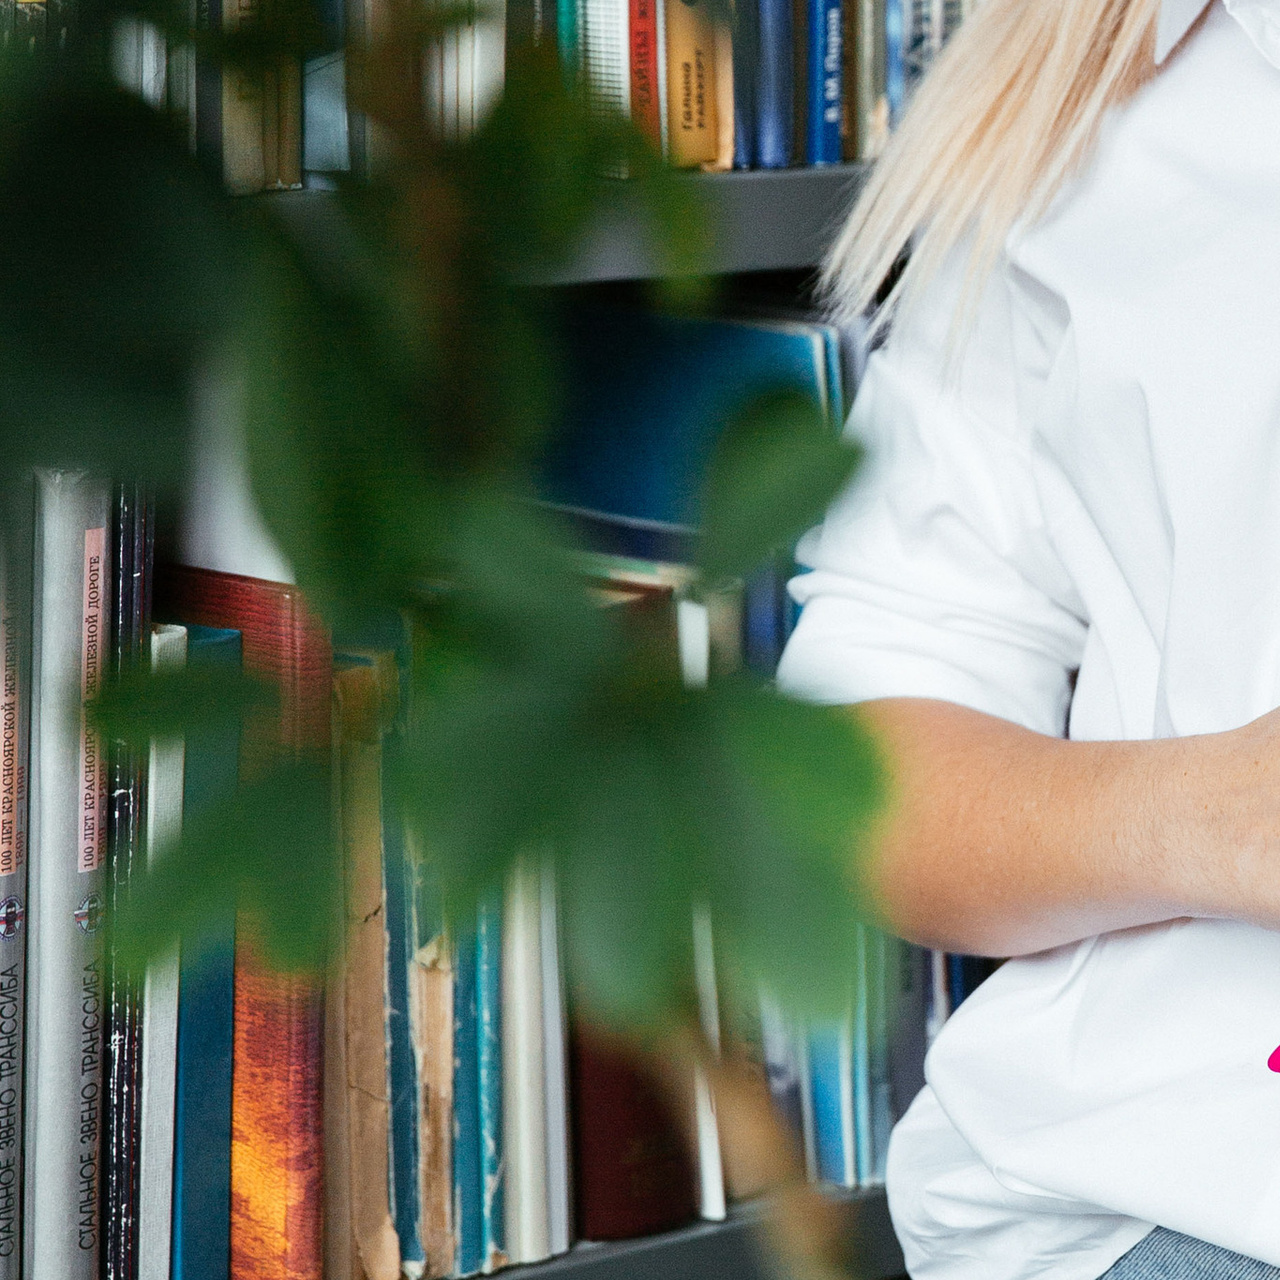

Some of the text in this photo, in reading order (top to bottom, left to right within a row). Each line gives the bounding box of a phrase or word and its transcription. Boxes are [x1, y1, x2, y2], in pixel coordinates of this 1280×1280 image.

[88, 555, 102, 610] ДОРОГЕ
[84, 614, 99, 695] ЖЕЛЕЗНОЙ
[0, 701, 15, 815] КРАСНОЯРСКОЙ
[0, 819, 14, 847] ЛЕТ
[83, 816, 96, 843] ЛЕТ
[1, 851, 13, 873] 100
[83, 847, 95, 869] 100
[0, 963, 19, 1258] СТАЛЬНОЕ ЗВЕНО ТРАНССИБА
[78, 959, 101, 1251] СТАЛЬНОЕ ЗВЕНО ТРАНССИБА
